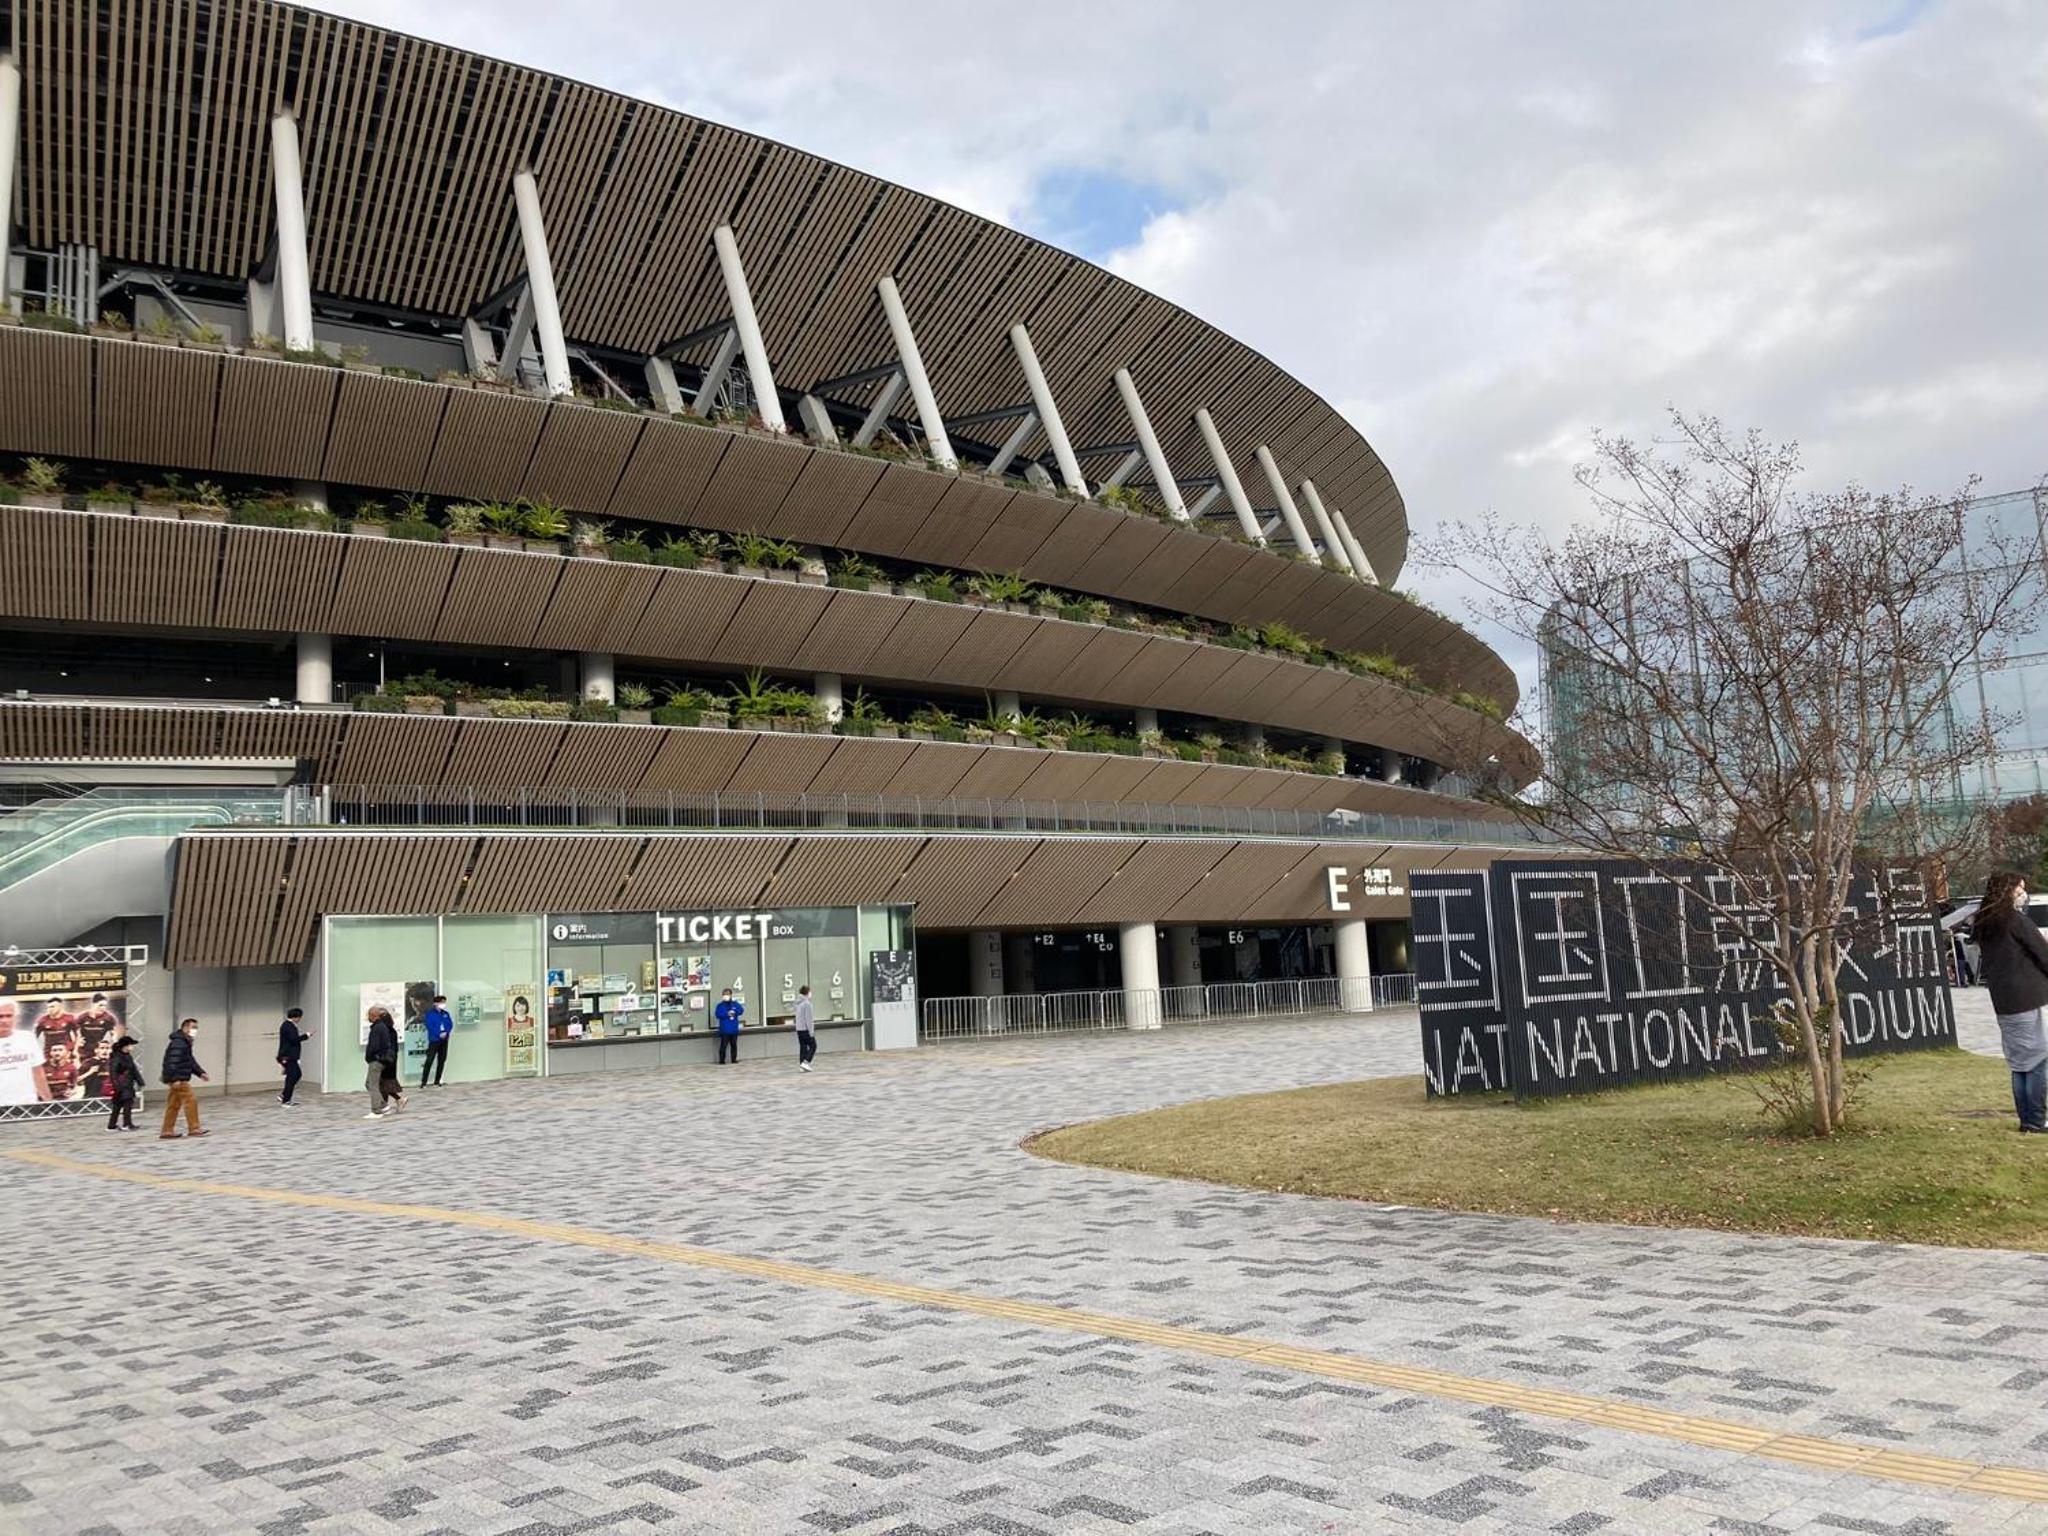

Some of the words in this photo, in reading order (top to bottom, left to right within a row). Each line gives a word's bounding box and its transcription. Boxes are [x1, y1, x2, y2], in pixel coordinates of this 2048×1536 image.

[1328, 867, 1351, 911] E
[657, 914, 773, 943] TICKET
[773, 925, 794, 936] BOX
[1043, 934, 1054, 945] E2
[1094, 933, 1104, 943] E4
[1228, 930, 1244, 944] E6
[890, 951, 897, 962] E
[733, 976, 743, 990] 4
[784, 974, 793, 988] 5
[833, 971, 842, 985] 6
[571, 985, 579, 1000] 1
[626, 982, 636, 997] 2
[1526, 1001, 1768, 1082] NATIONAL
[1774, 985, 1949, 1053] SDIUM
